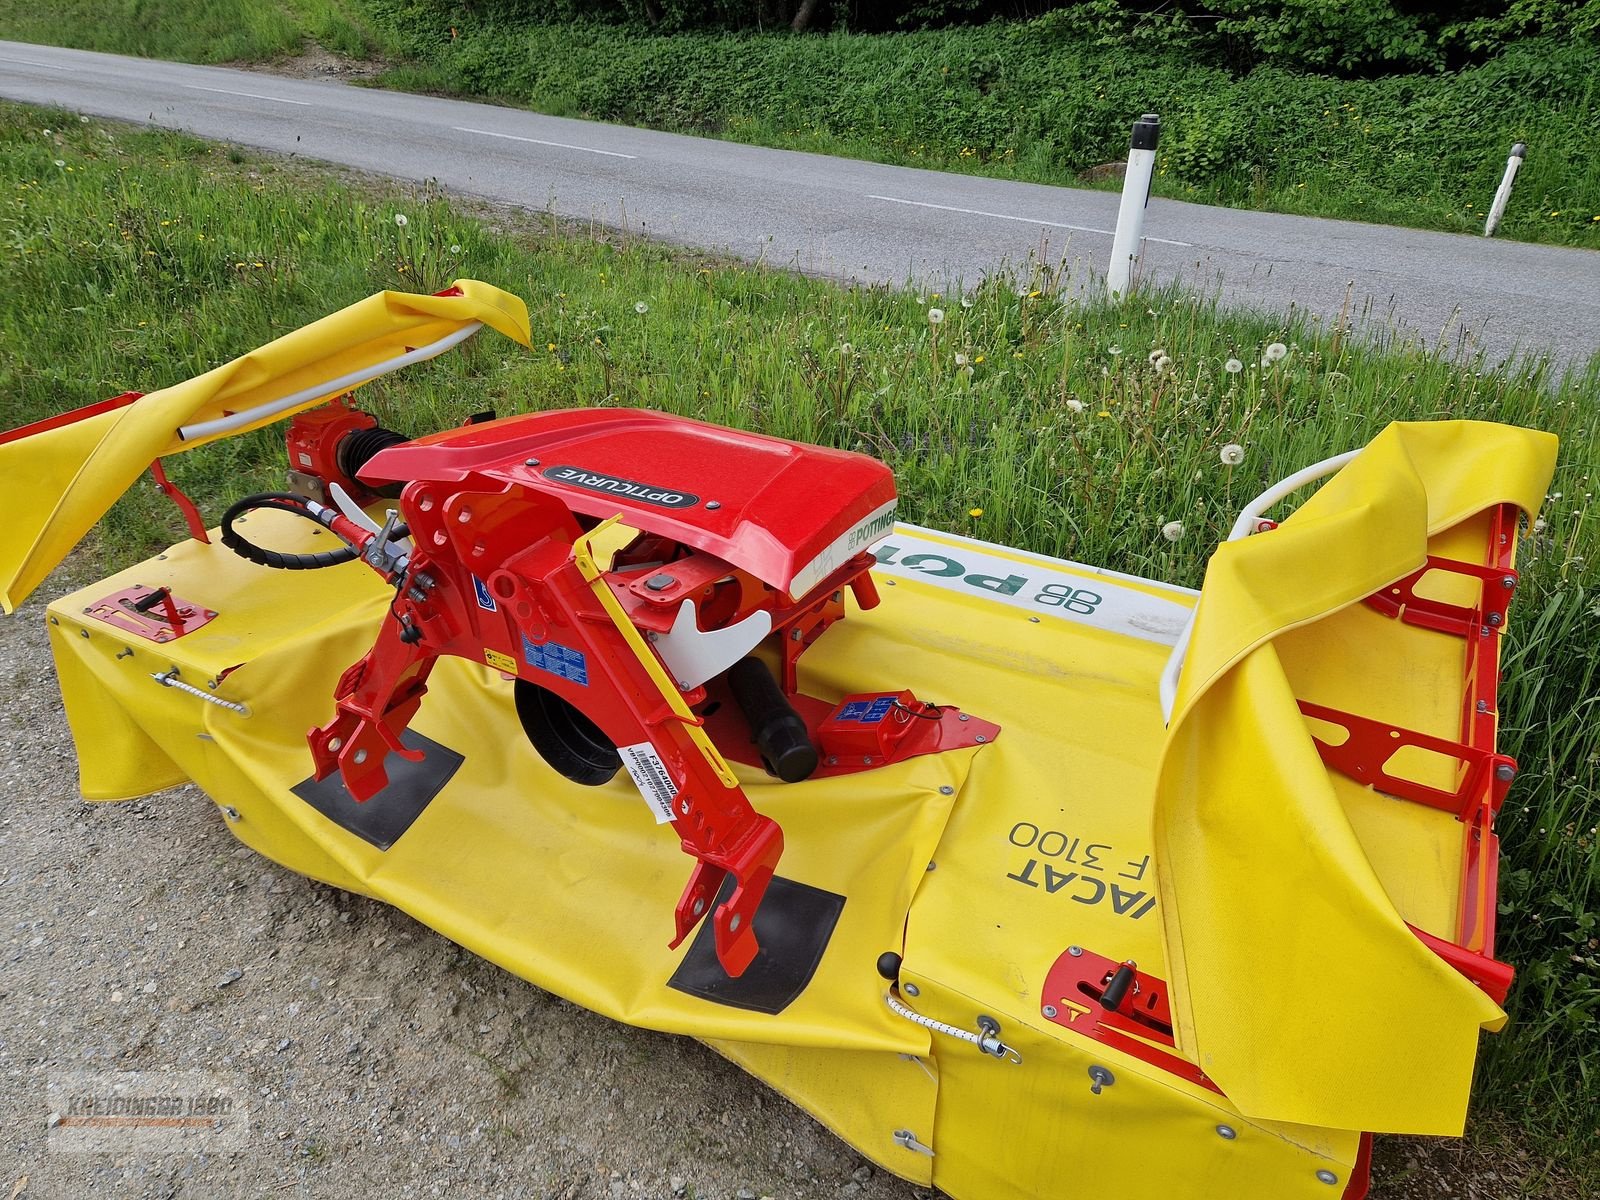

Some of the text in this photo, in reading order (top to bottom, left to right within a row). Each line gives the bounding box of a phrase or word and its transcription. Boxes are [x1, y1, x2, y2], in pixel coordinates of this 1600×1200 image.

[556, 469, 684, 504] OPTICURVE
[649, 755, 677, 798] F3764000
[1008, 822, 1150, 881] F 3100
